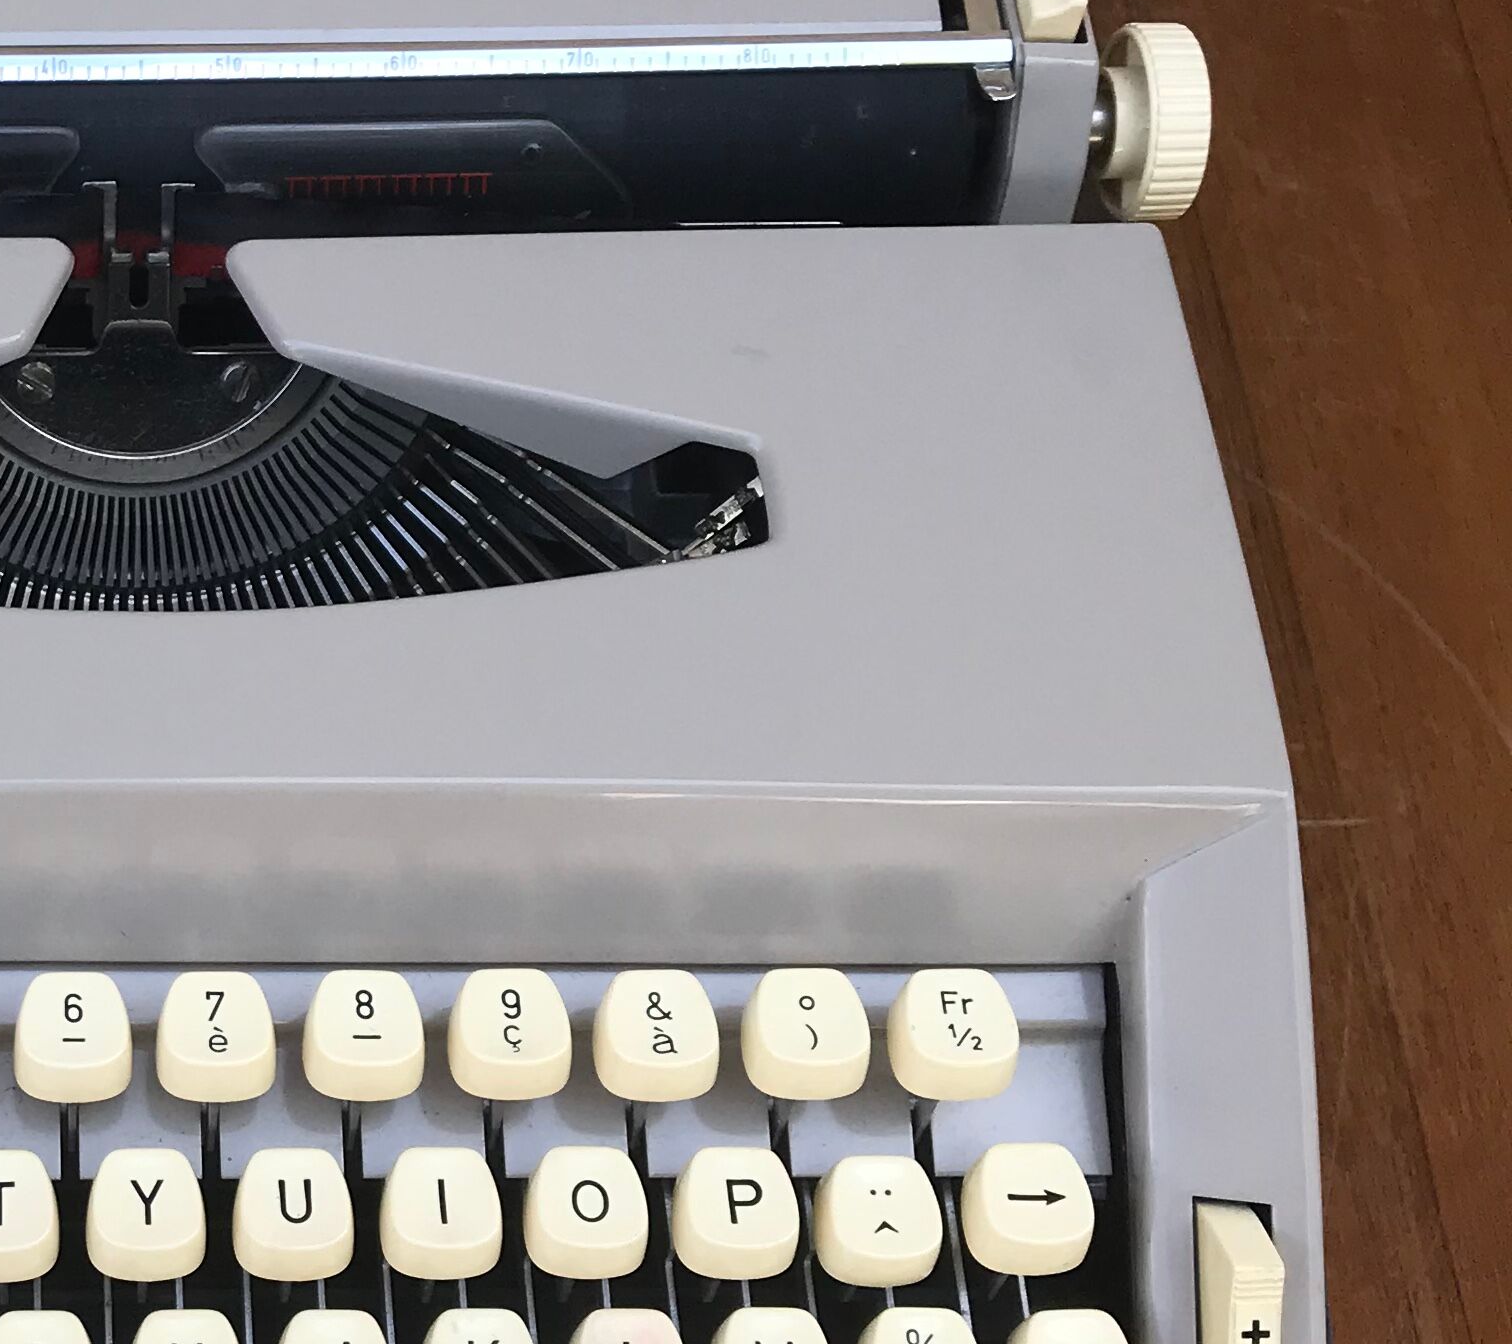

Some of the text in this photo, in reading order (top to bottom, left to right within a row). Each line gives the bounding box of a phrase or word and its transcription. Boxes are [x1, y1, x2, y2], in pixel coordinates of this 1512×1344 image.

[40, 57, 68, 76] 40
[214, 56, 243, 74] 50
[389, 54, 418, 72] 60
[566, 50, 595, 68] 70
[742, 48, 772, 66] 80
[64, 993, 83, 1024] 6
[205, 991, 225, 1022] 7
[355, 989, 375, 1020] 8
[501, 988, 522, 1020] 9
[646, 991, 673, 1021] &
[940, 990, 973, 1015] Fr
[208, 1026, 228, 1053] è
[503, 1024, 522, 1053] ç
[652, 1026, 678, 1055] à
[805, 1023, 818, 1050] )
[130, 1179, 164, 1226] Y
[278, 1178, 313, 1224] U
[437, 1178, 448, 1225] I
[571, 1179, 610, 1223] O
[725, 1178, 763, 1225] P
